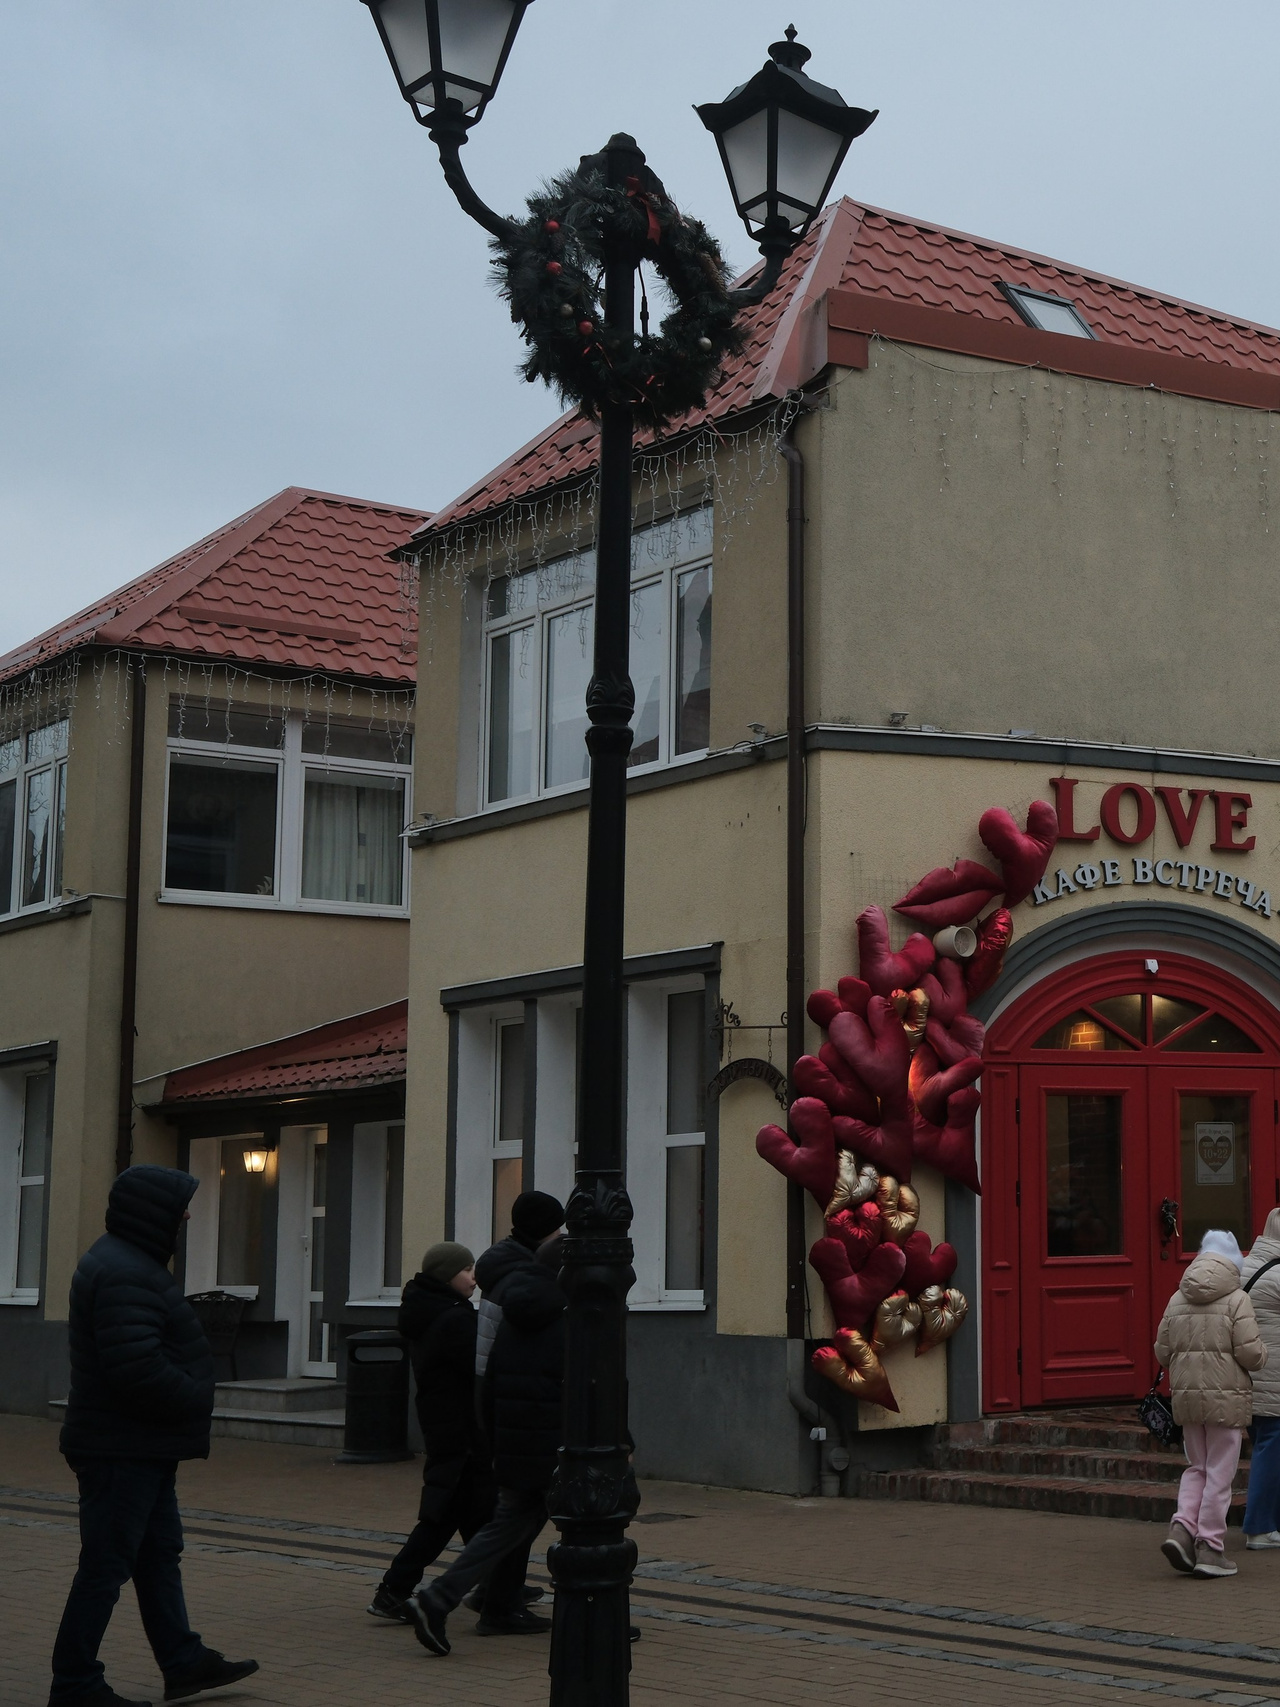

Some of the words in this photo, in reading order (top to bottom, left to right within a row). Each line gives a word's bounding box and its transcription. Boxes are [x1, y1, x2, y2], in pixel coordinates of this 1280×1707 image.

[1050, 778, 1256, 851] LOVE
[1031, 859, 1123, 905] КАФЕ
[1132, 858, 1273, 918] ВСТРЕЧА
